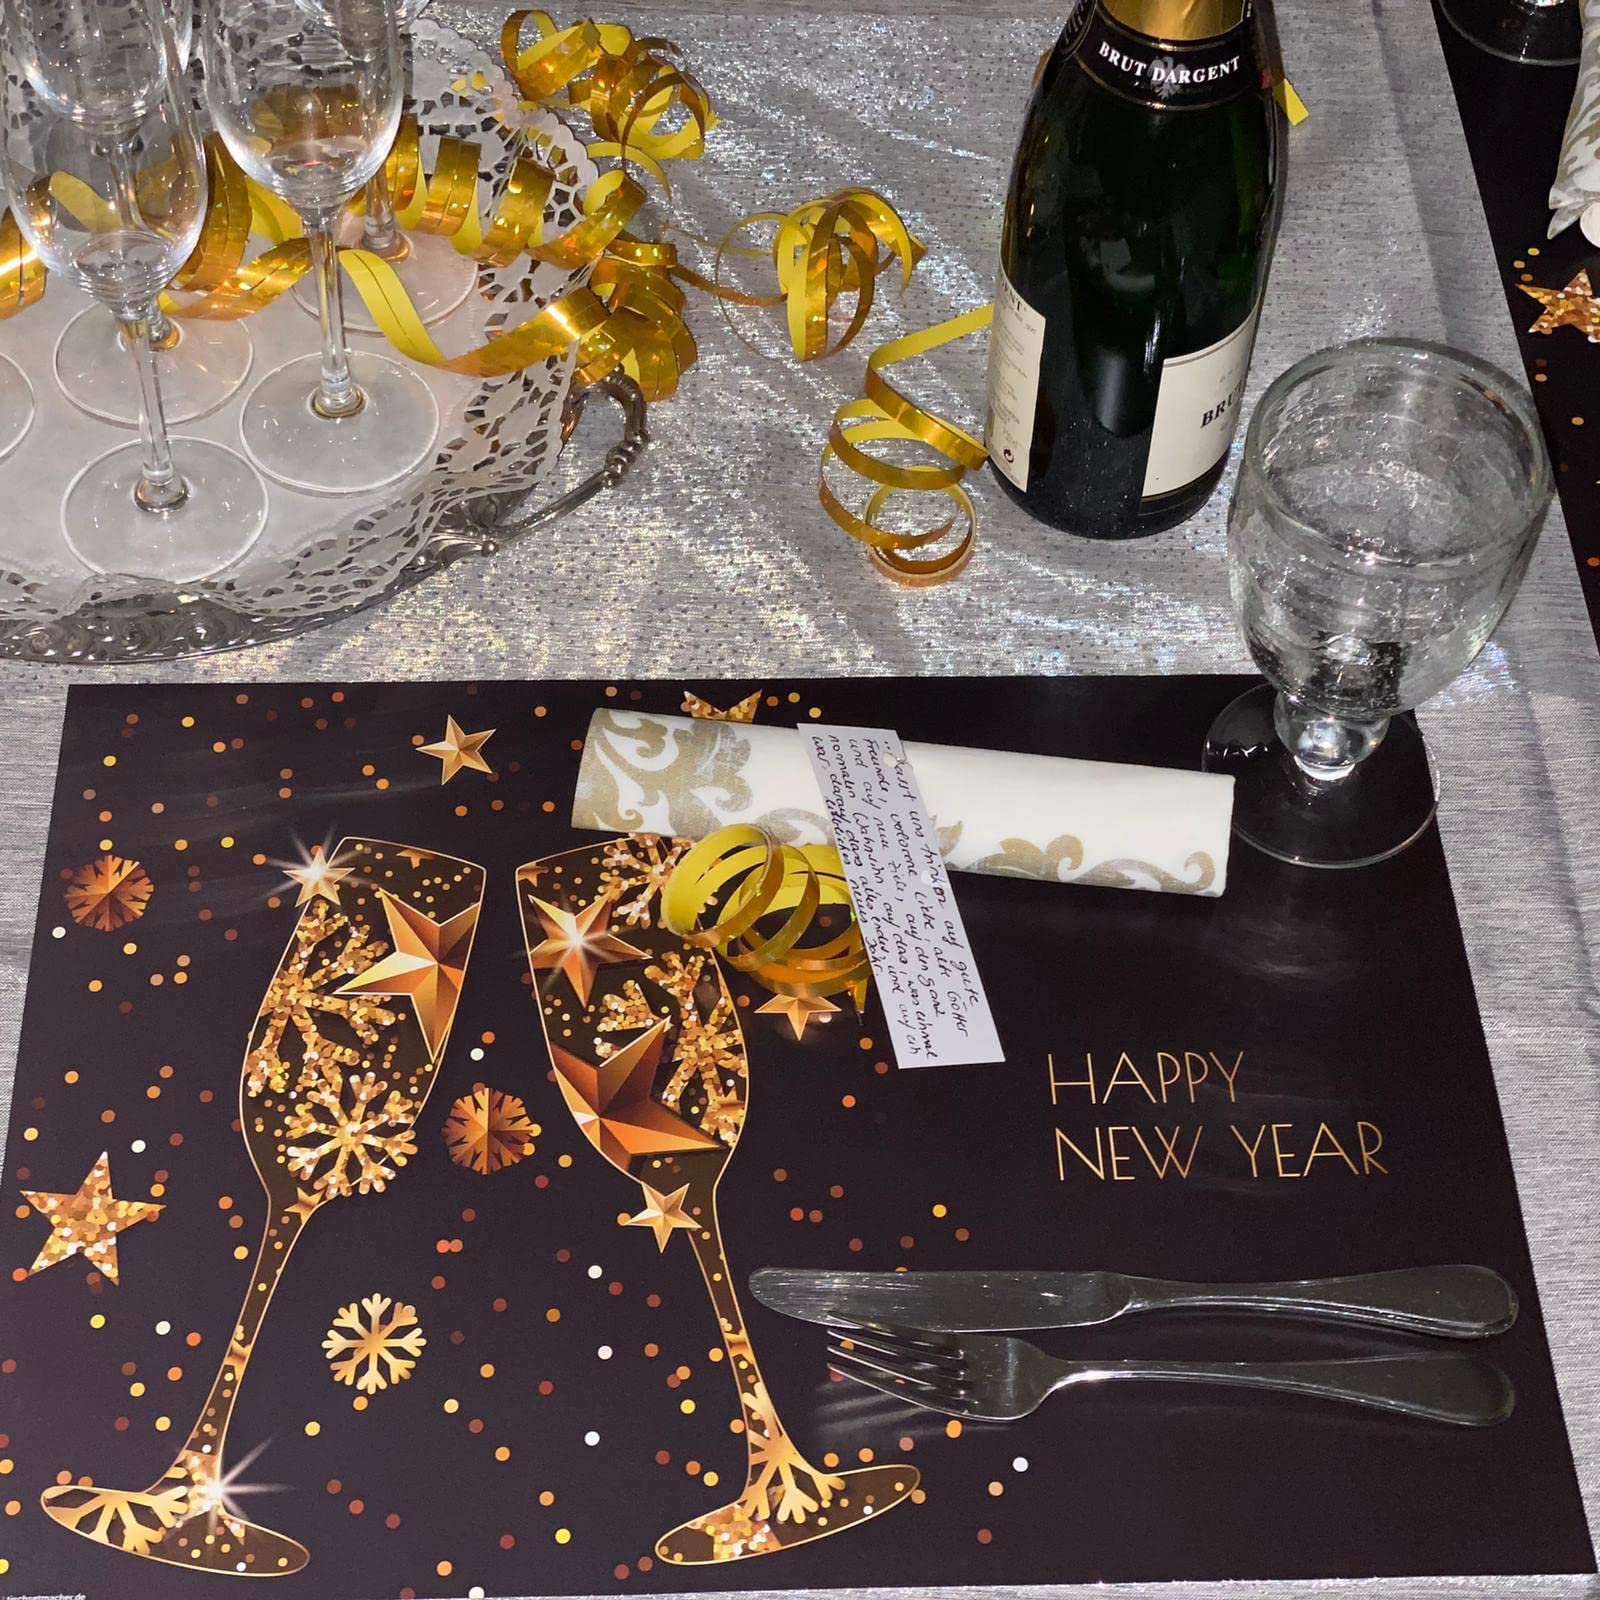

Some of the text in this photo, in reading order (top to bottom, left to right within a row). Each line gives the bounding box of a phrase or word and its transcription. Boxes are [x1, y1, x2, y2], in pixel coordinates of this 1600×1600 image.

[1099, 41, 1240, 84] BRUT DARGENT
[949, 960, 979, 1009] gute
[1048, 1051, 1243, 1105] HAPPY
[1055, 1120, 1389, 1181] NEW YEAR
